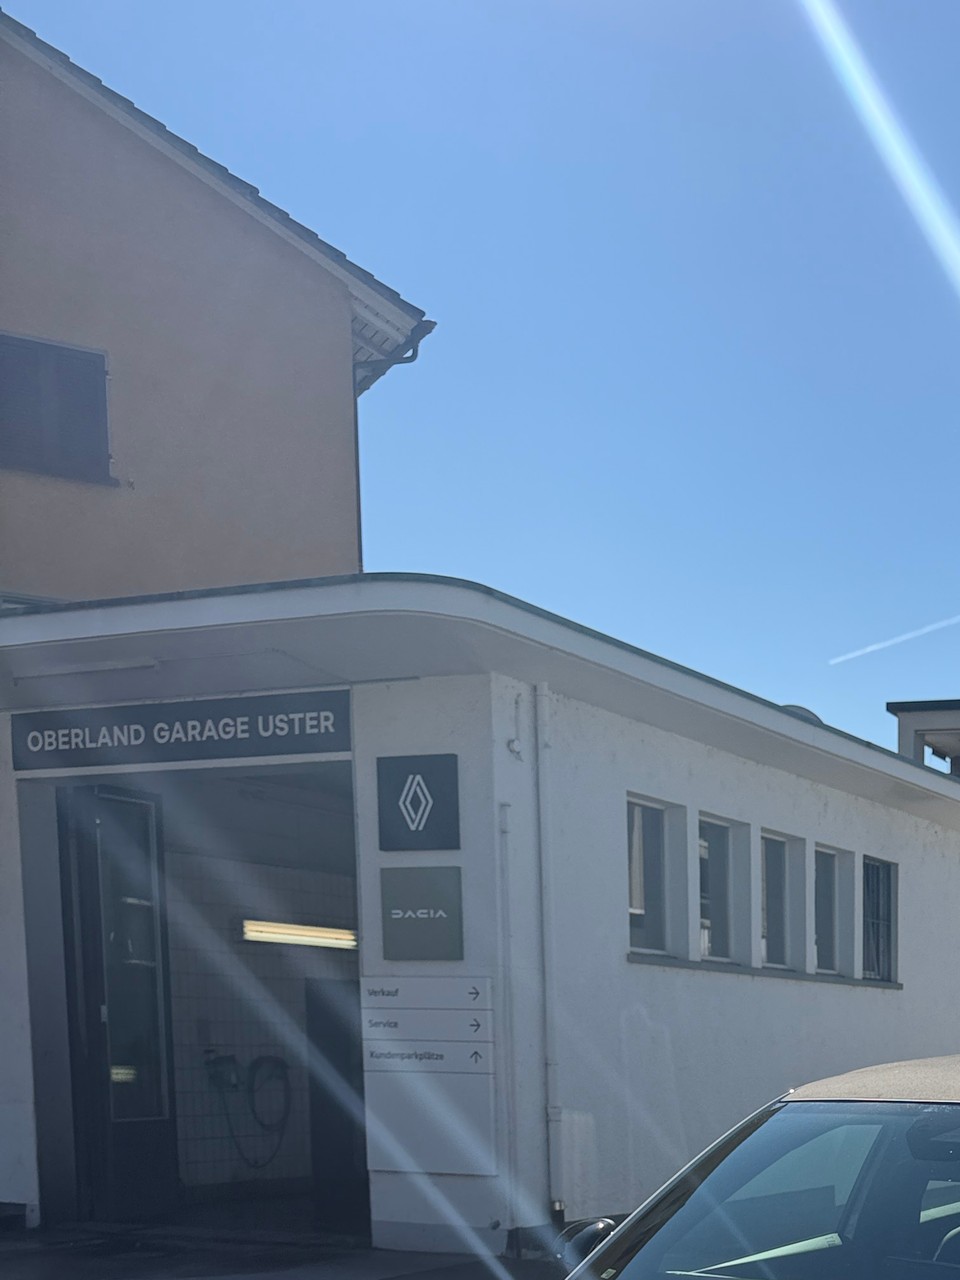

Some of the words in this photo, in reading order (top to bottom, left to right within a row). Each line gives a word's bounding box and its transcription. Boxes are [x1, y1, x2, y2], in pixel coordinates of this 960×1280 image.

[27, 724, 146, 752] OBERLAND
[153, 717, 250, 744] GARAGE
[258, 711, 335, 737] USTER
[391, 909, 448, 919] DACIA
[367, 988, 399, 997] Verkauf
[368, 1019, 398, 1028] Service
